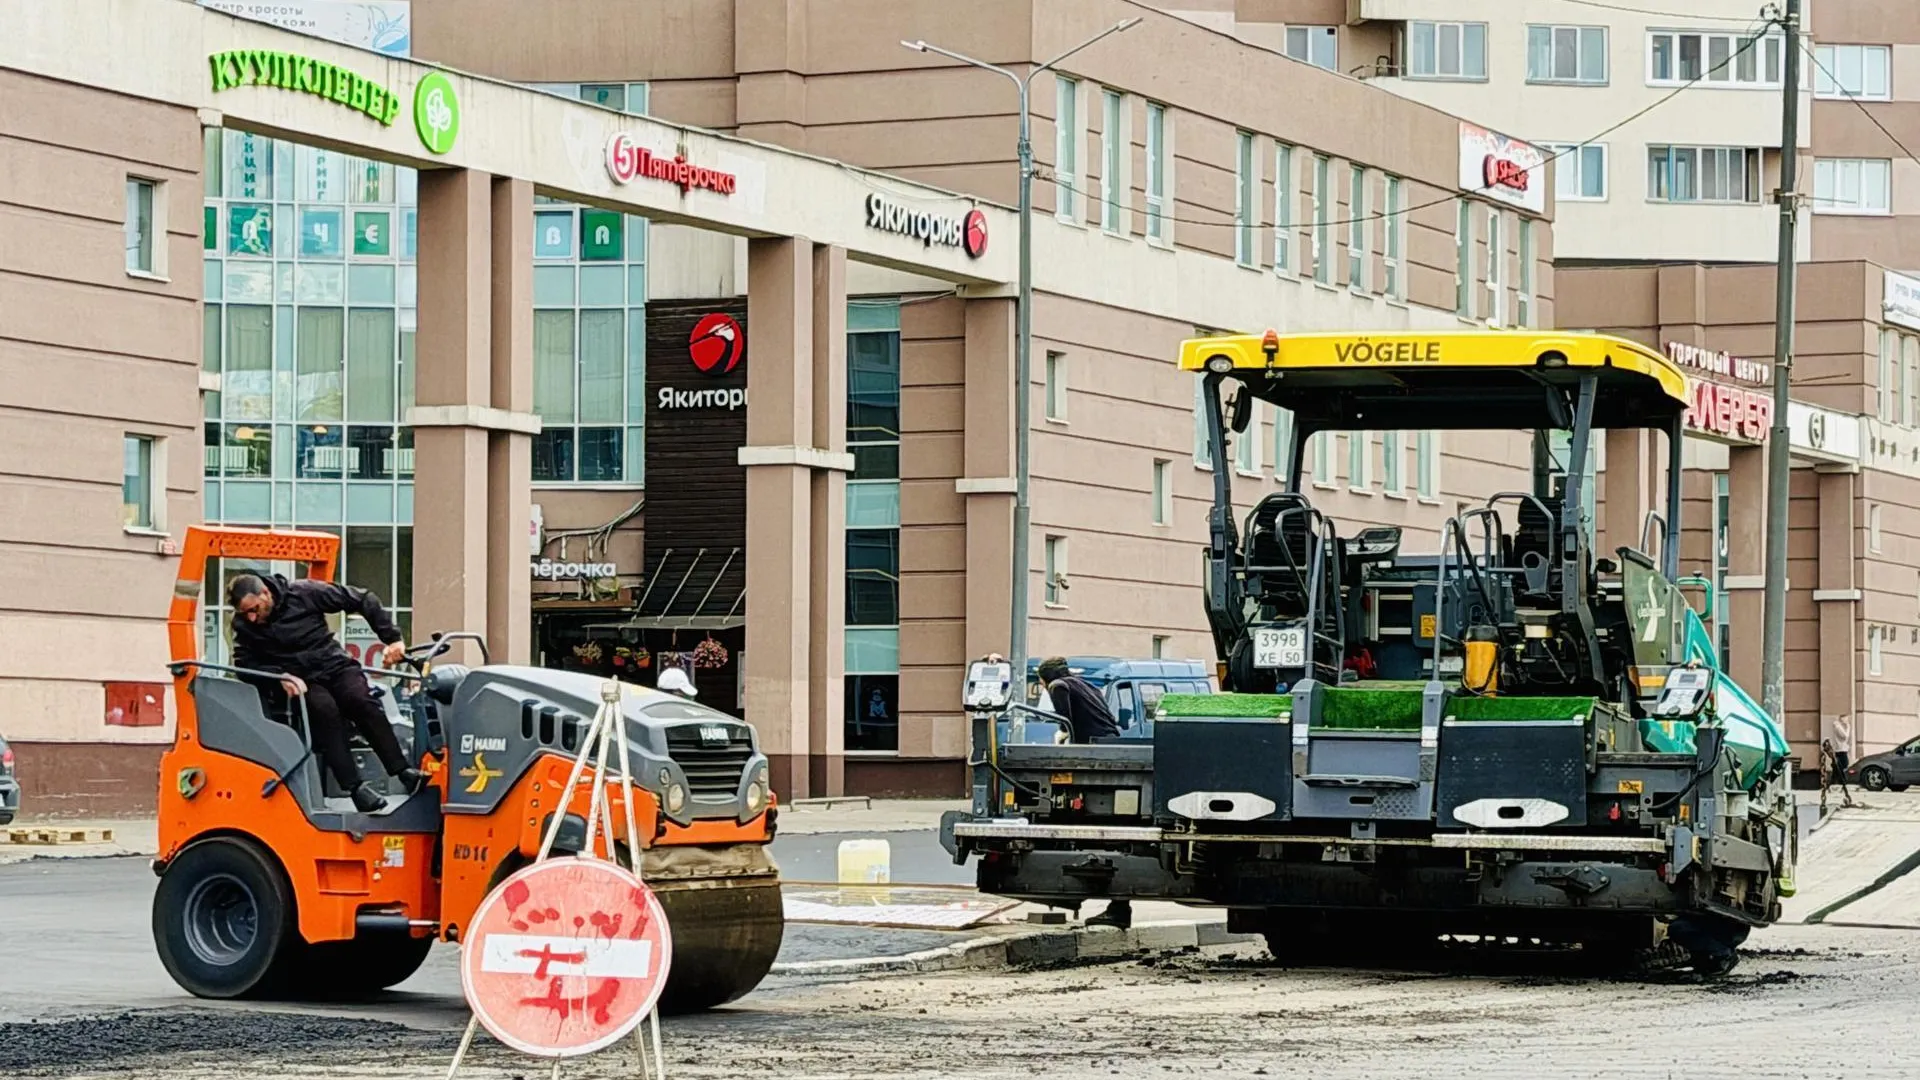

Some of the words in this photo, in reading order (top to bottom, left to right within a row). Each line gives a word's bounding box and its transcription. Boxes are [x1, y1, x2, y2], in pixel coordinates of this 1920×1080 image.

[210, 3, 244, 13] ентр
[248, 5, 304, 15] красоты
[208, 50, 401, 126] КУУЛКЛЕВЕР
[637, 147, 736, 195] Пятёрочка
[867, 192, 963, 247] Якитория
[1334, 337, 1440, 362] VÖGELE
[1668, 341, 1730, 375] ТОРГОВЫЙ
[1735, 358, 1769, 384] ЦЕНТР
[658, 387, 748, 411] Якитор
[1261, 633, 1298, 647] 3998
[1285, 651, 1300, 663] 50
[474, 737, 507, 751] HAMM
